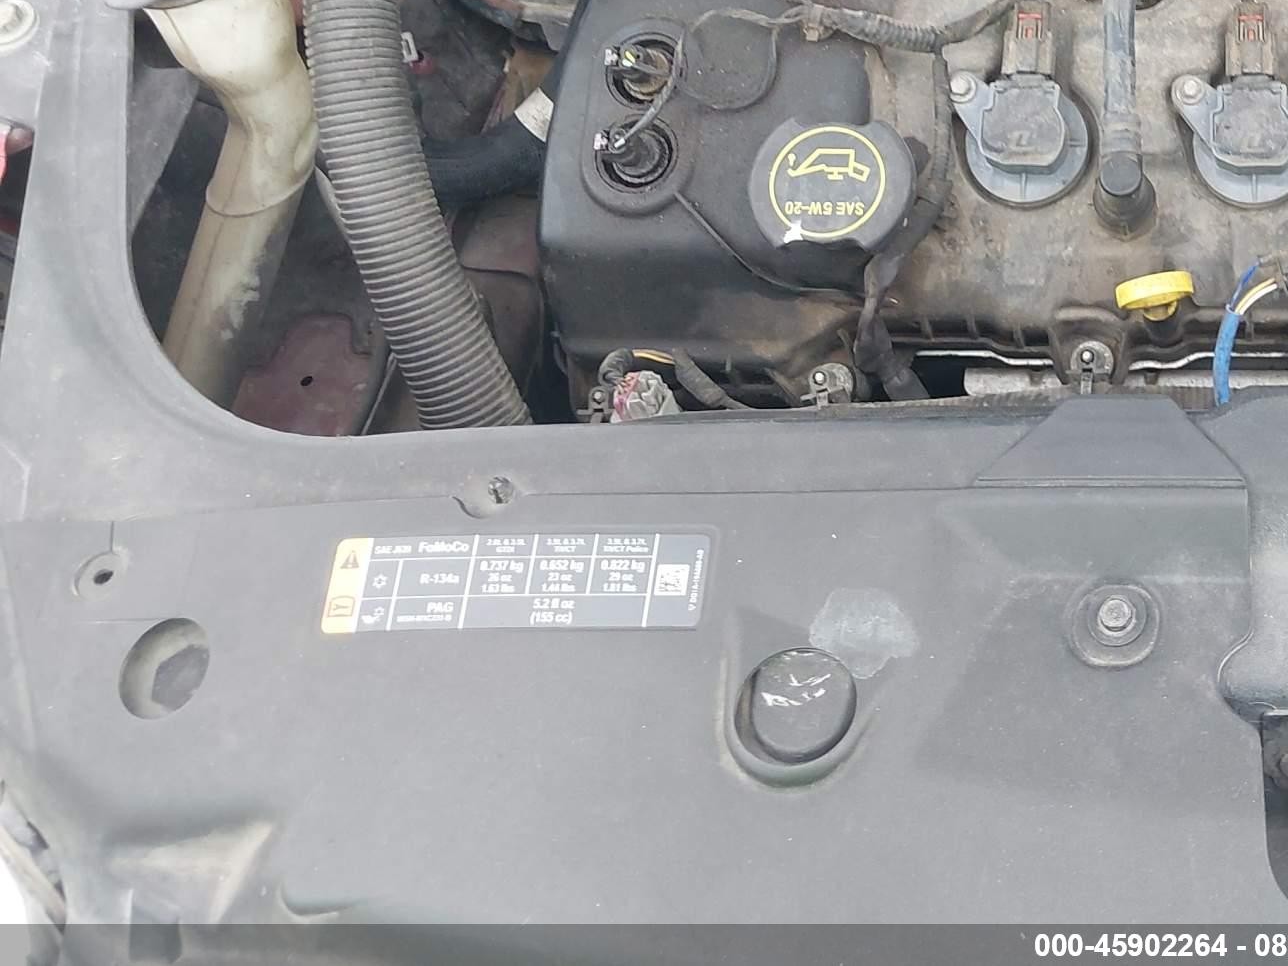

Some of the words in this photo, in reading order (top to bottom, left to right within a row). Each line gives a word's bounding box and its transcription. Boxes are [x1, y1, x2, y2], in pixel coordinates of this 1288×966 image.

[784, 201, 833, 216] 5W-20
[836, 202, 865, 216] SAE
[418, 541, 470, 553] FoMoCo
[480, 560, 509, 571] 0.737
[510, 560, 524, 574] kg
[570, 559, 584, 573] kg
[631, 559, 646, 573] kg
[419, 573, 460, 585] R-134a
[501, 574, 512, 582] oz
[548, 572, 560, 582] 23
[560, 574, 572, 582] oz
[608, 572, 621, 582] 29
[622, 574, 634, 582] oz
[500, 583, 515, 593] lbs
[561, 583, 575, 592] lbs
[622, 582, 637, 592] lbs
[426, 602, 454, 613] PAG
[532, 598, 550, 609] 5.2
[561, 600, 575, 609] oz
[530, 611, 554, 625] (155
[555, 610, 573, 625] cc)
